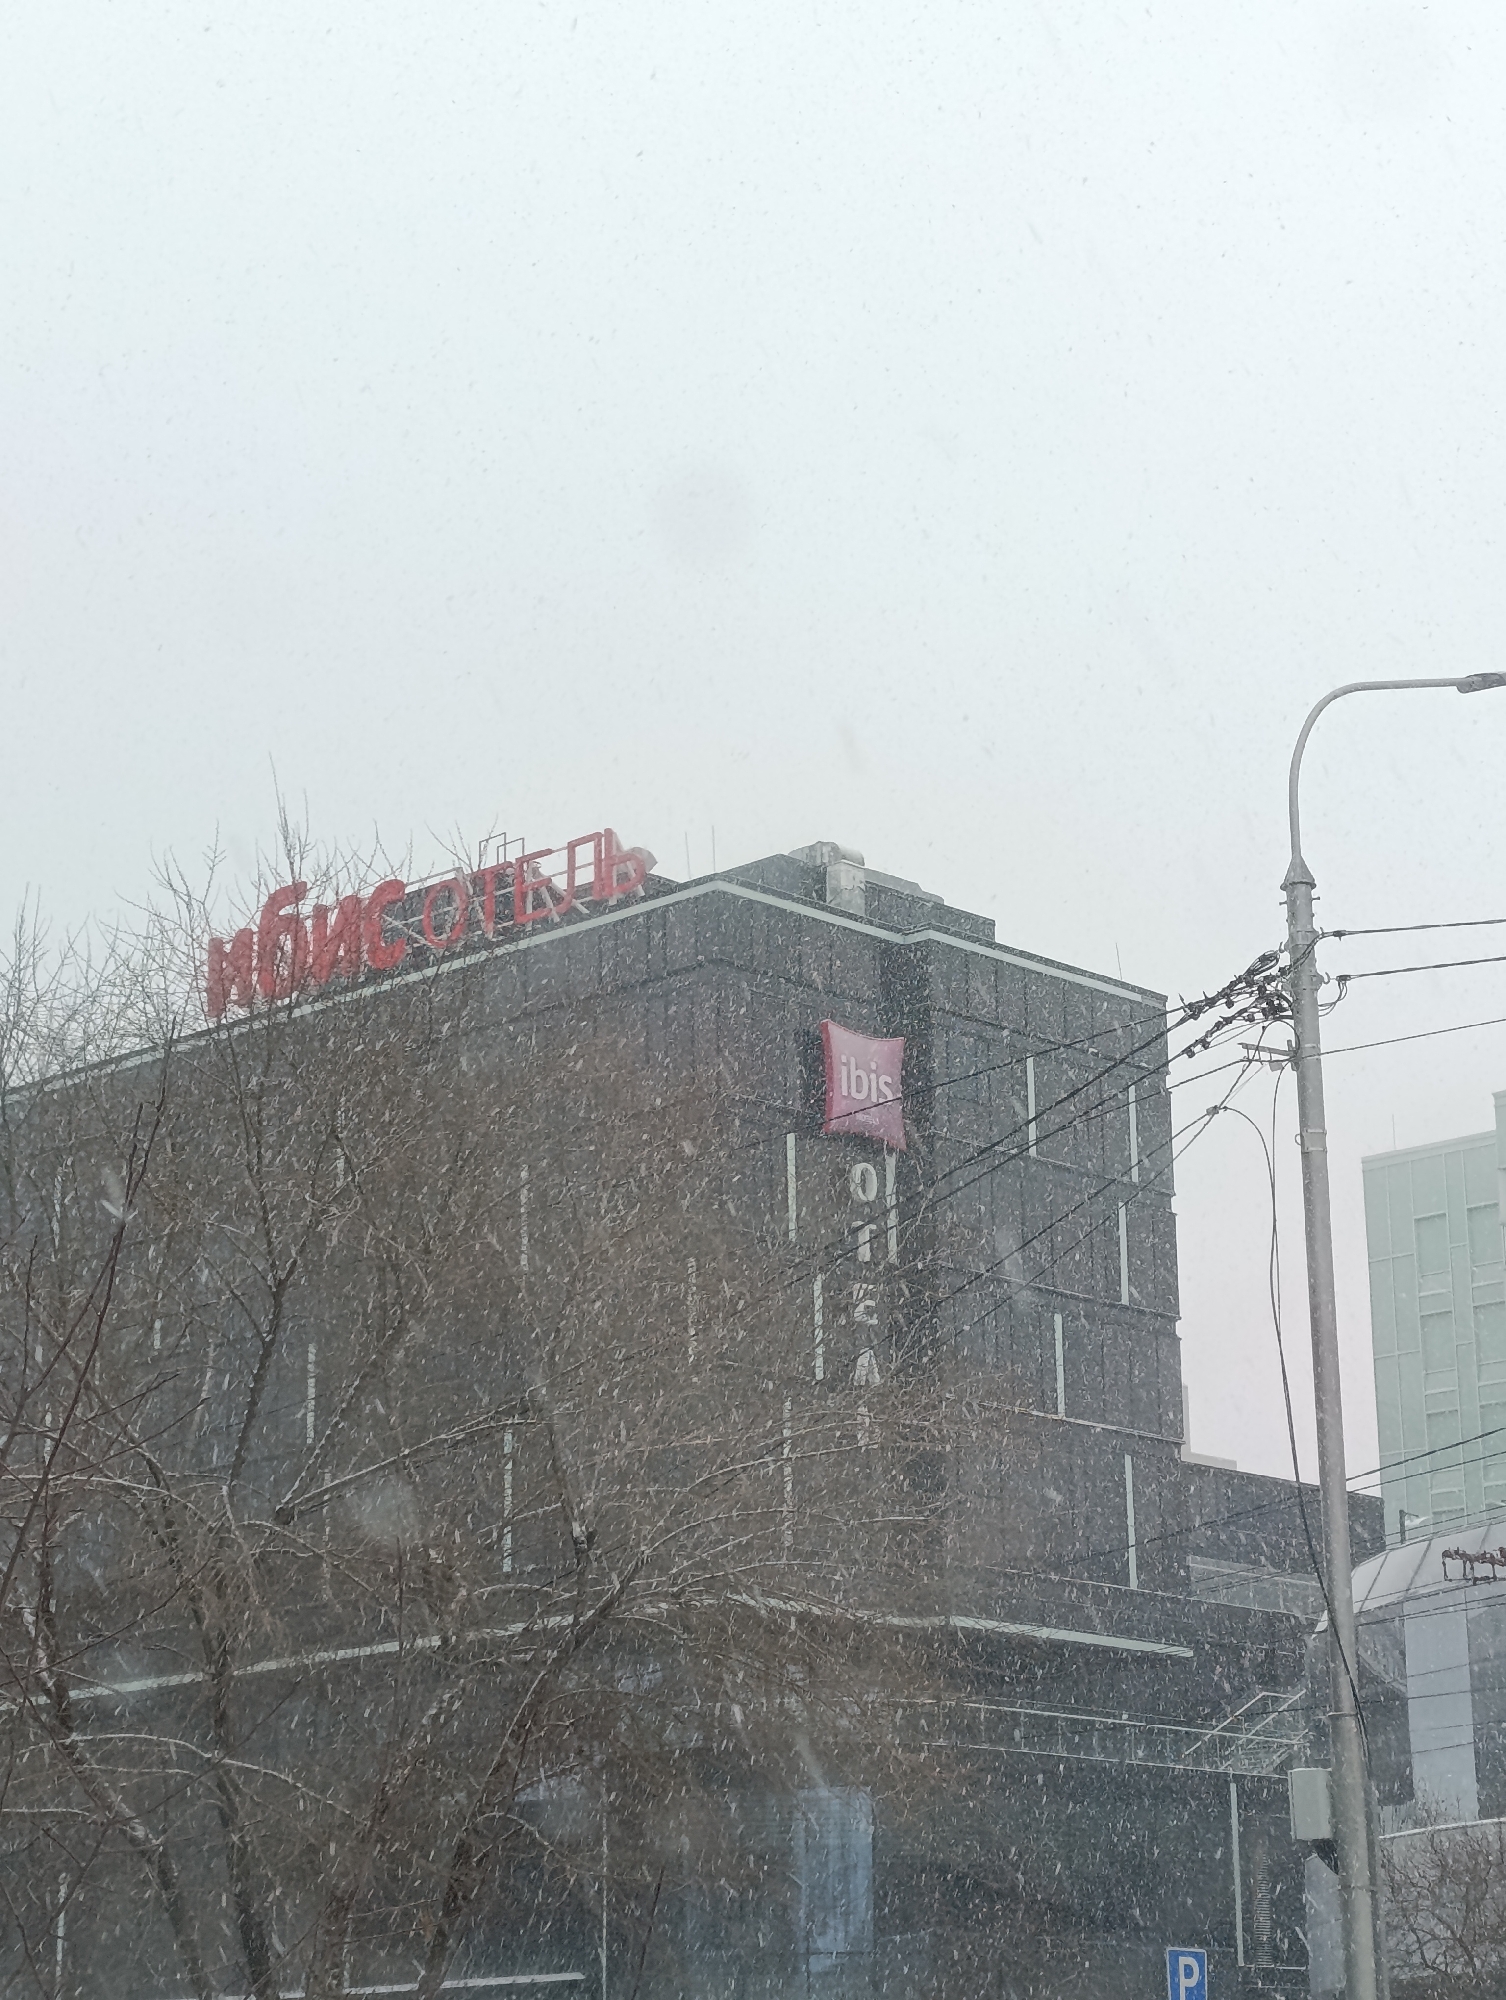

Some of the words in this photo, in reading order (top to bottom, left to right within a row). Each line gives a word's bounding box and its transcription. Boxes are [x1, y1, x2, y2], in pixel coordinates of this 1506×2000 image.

[422, 827, 645, 949] ОТЕЛЬ
[840, 1054, 895, 1106] ibis
[1179, 1956, 1200, 2000] P
